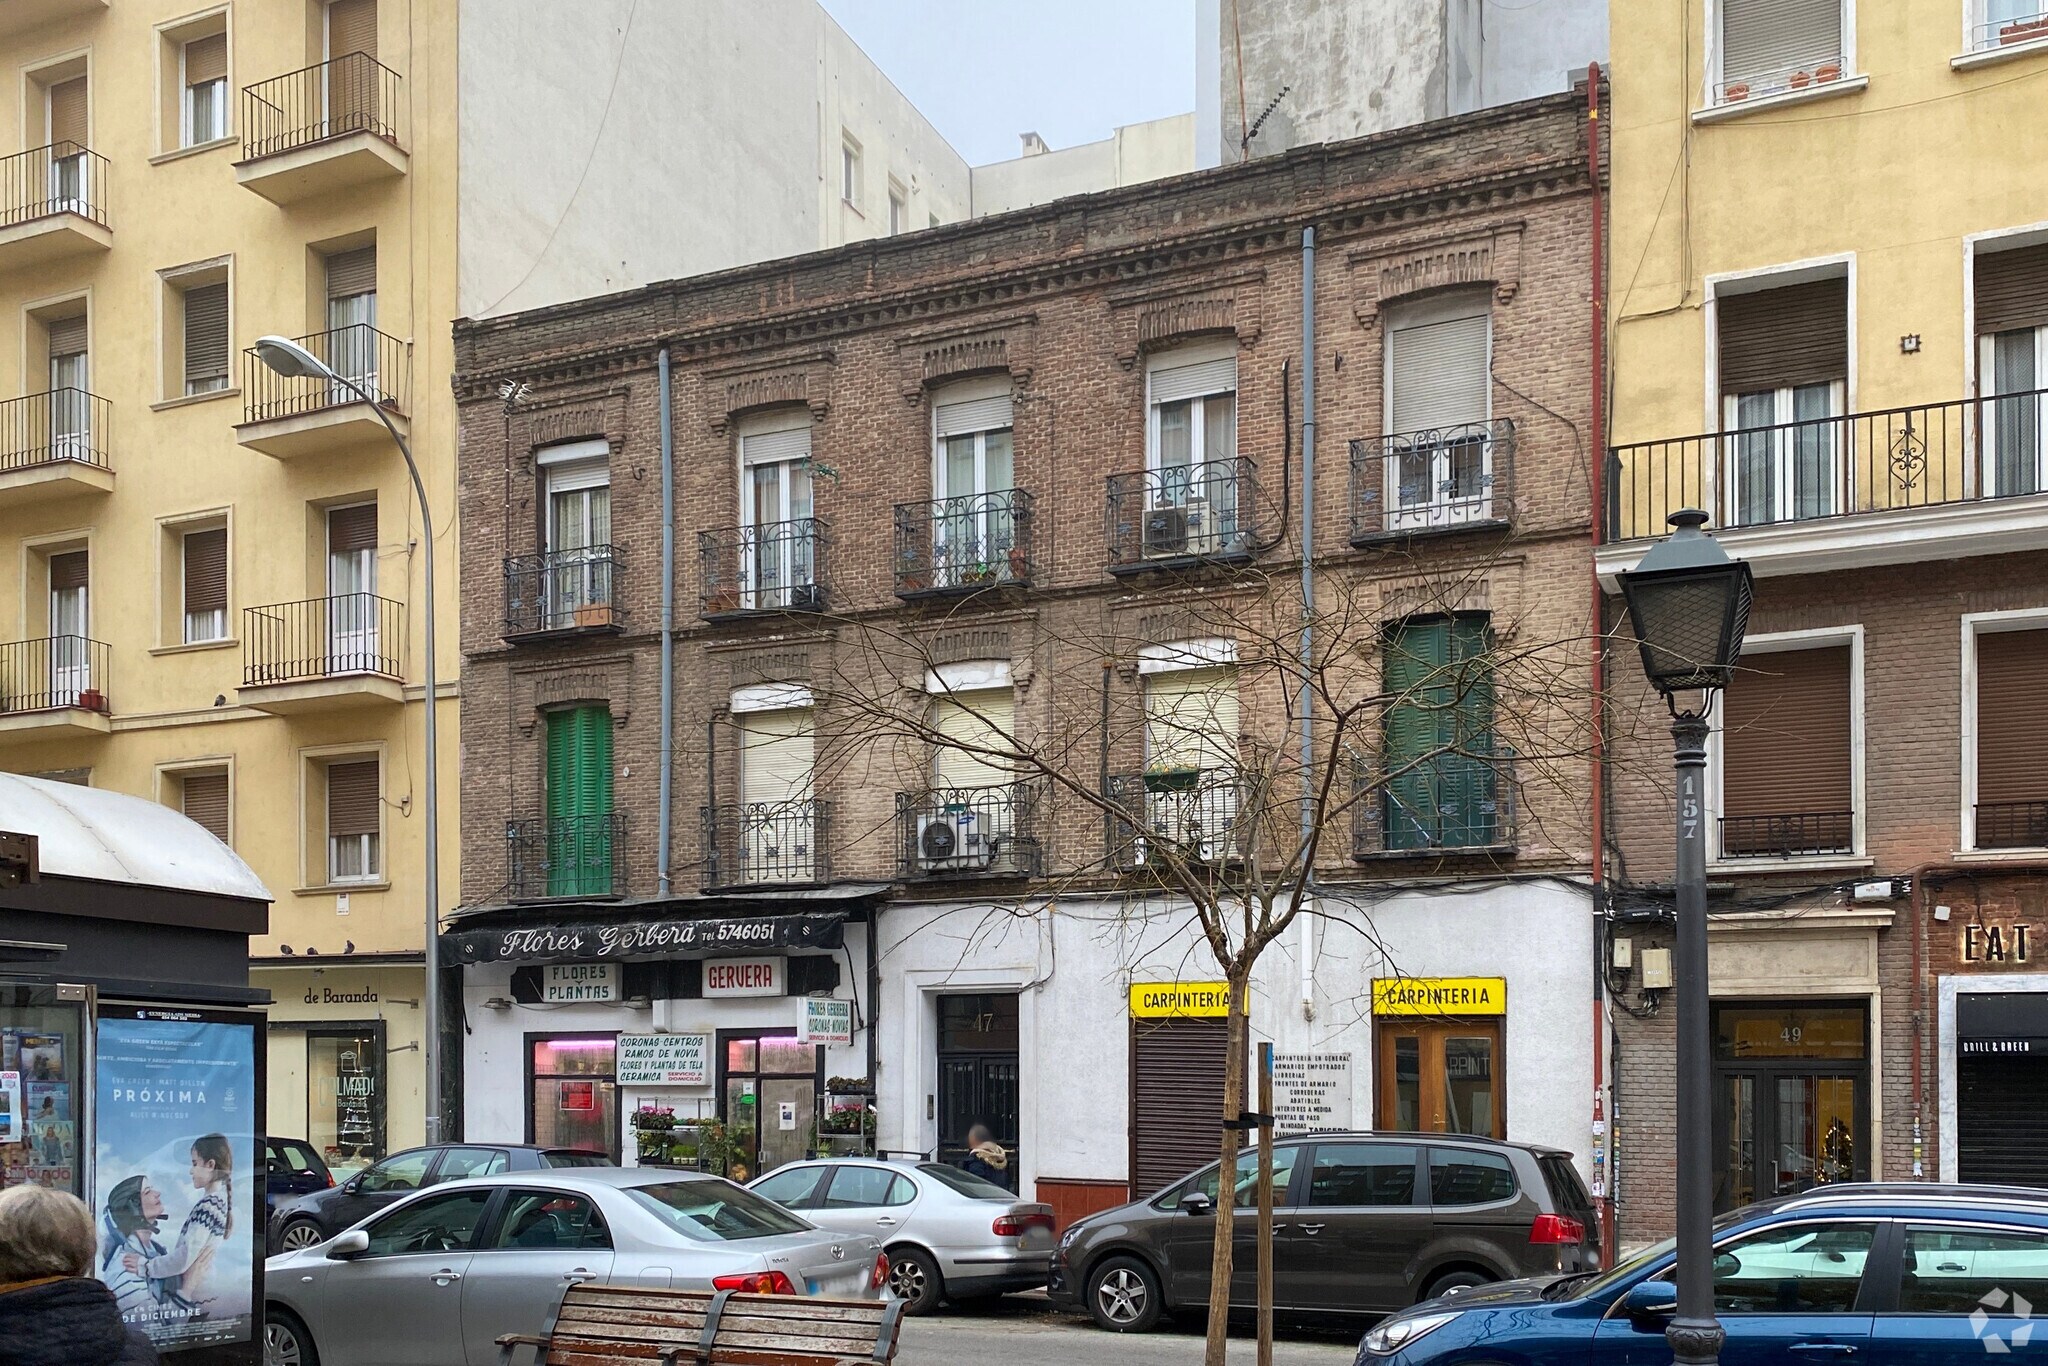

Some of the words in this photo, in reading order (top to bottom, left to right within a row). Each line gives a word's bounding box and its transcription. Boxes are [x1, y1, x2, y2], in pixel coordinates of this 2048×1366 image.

[499, 929, 585, 957] Flores
[597, 922, 697, 957] Gerbera
[717, 923, 775, 941] 5746051
[1964, 924, 2031, 961] EAT
[552, 965, 607, 981] FLORES
[708, 964, 773, 989] GERVERA
[304, 988, 319, 1004] de
[323, 986, 378, 1004] Baranda
[549, 985, 609, 1000] PLANTAS
[1143, 991, 1230, 1009] CARPINTERIA
[1388, 987, 1490, 1005] CARPINTERIA
[1780, 1026, 1802, 1042] 49
[625, 1049, 655, 1058] RAMOS
[658, 1049, 671, 1058] DE
[674, 1048, 699, 1058] NOVIA
[1963, 1042, 1990, 1052] GRILL
[1992, 1042, 1999, 1052] &
[620, 1061, 642, 1070] FLORES
[644, 1061, 649, 1069] Y
[650, 1061, 676, 1070] PLANTAS
[678, 1061, 687, 1069] DE
[689, 1061, 703, 1070] TELA
[620, 1072, 662, 1081] CERAMICA
[113, 1087, 207, 1103] PRÓXIMA
[122, 1314, 137, 1324] DE
[140, 1308, 202, 1322] DICIEMBRE
